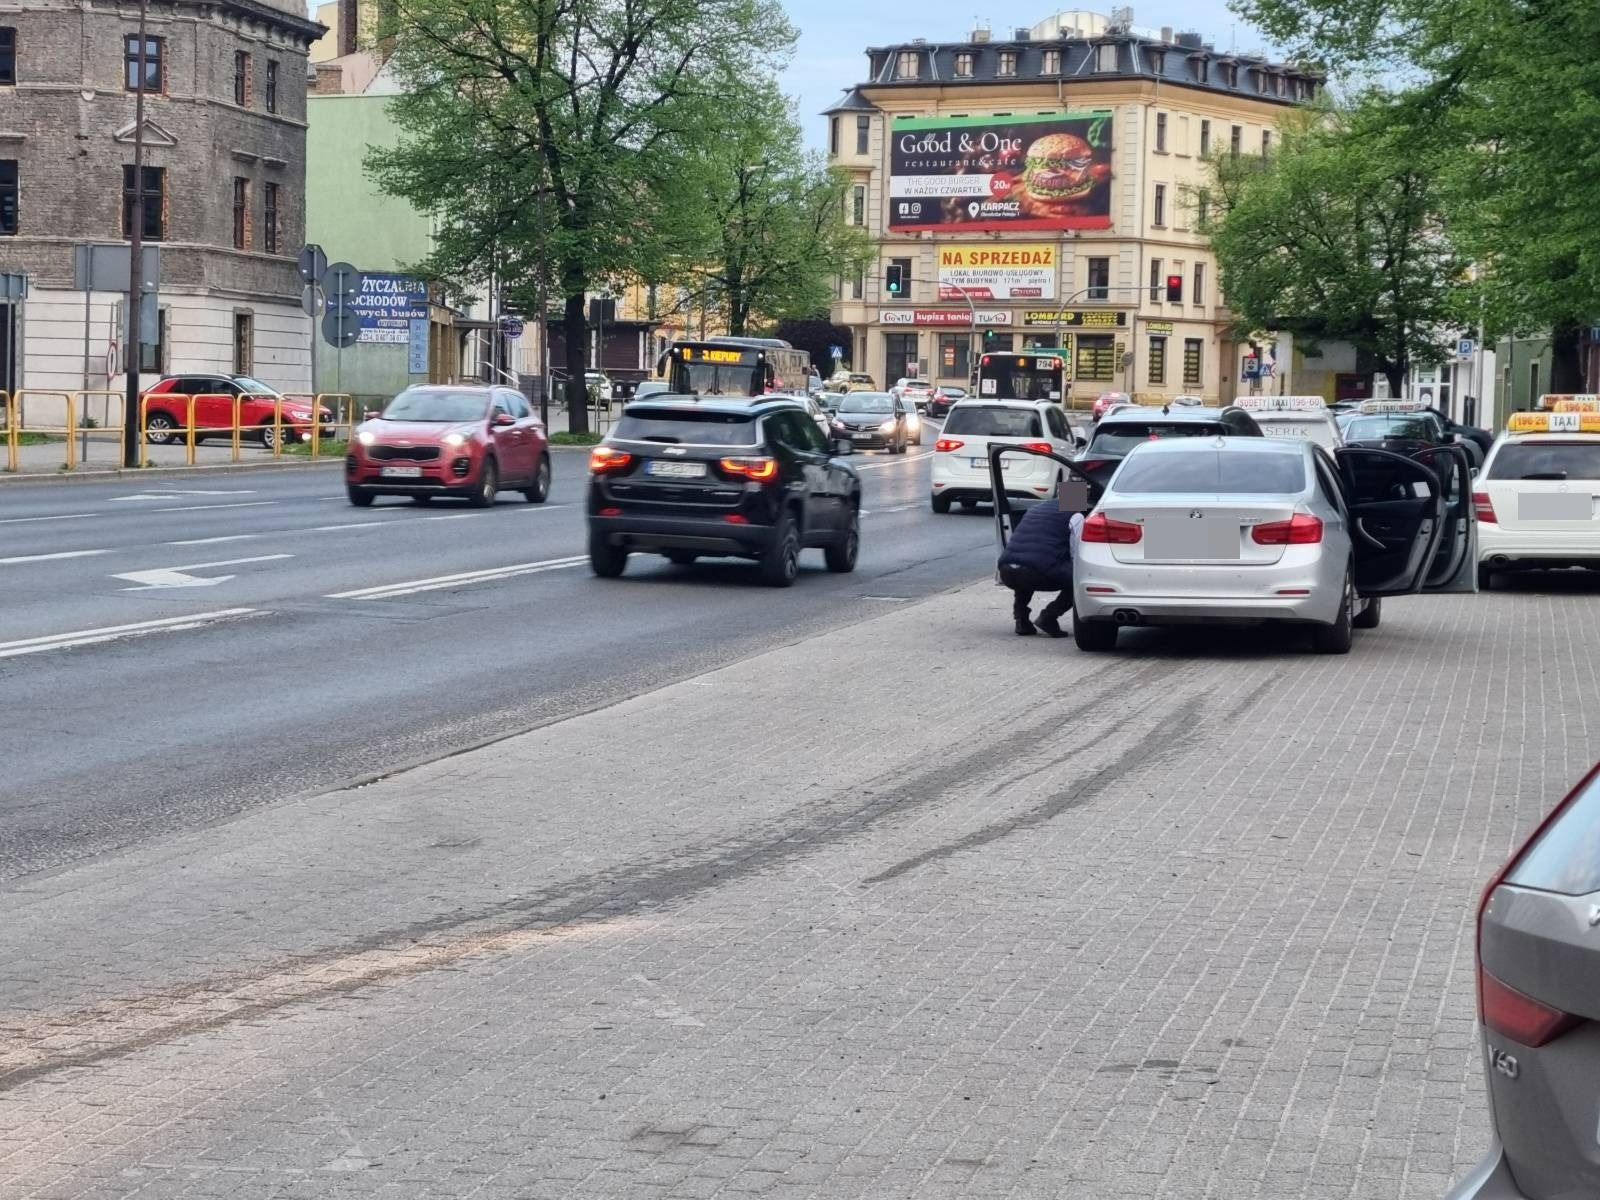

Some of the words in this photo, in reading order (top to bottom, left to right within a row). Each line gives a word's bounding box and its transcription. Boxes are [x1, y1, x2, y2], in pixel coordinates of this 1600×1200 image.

[900, 131, 951, 153] Good
[959, 132, 974, 152] &
[981, 132, 1021, 152] One
[908, 177, 922, 185] THE
[926, 177, 946, 185] GOOD
[949, 176, 979, 184] BURGER
[941, 186, 983, 194] CZWARTEK
[981, 202, 1020, 211] KARPACZ
[943, 252, 963, 265] NA
[970, 248, 1051, 265] SPRZEDAŻ
[950, 269, 970, 277] LOKAL
[392, 309, 425, 318] busów
[917, 312, 945, 323] kupisz
[947, 312, 972, 323] taniej
[1025, 312, 1074, 320] LOMBARD
[682, 347, 691, 361] 11
[1272, 399, 1288, 407] TAXI
[1553, 416, 1576, 426] TAXI
